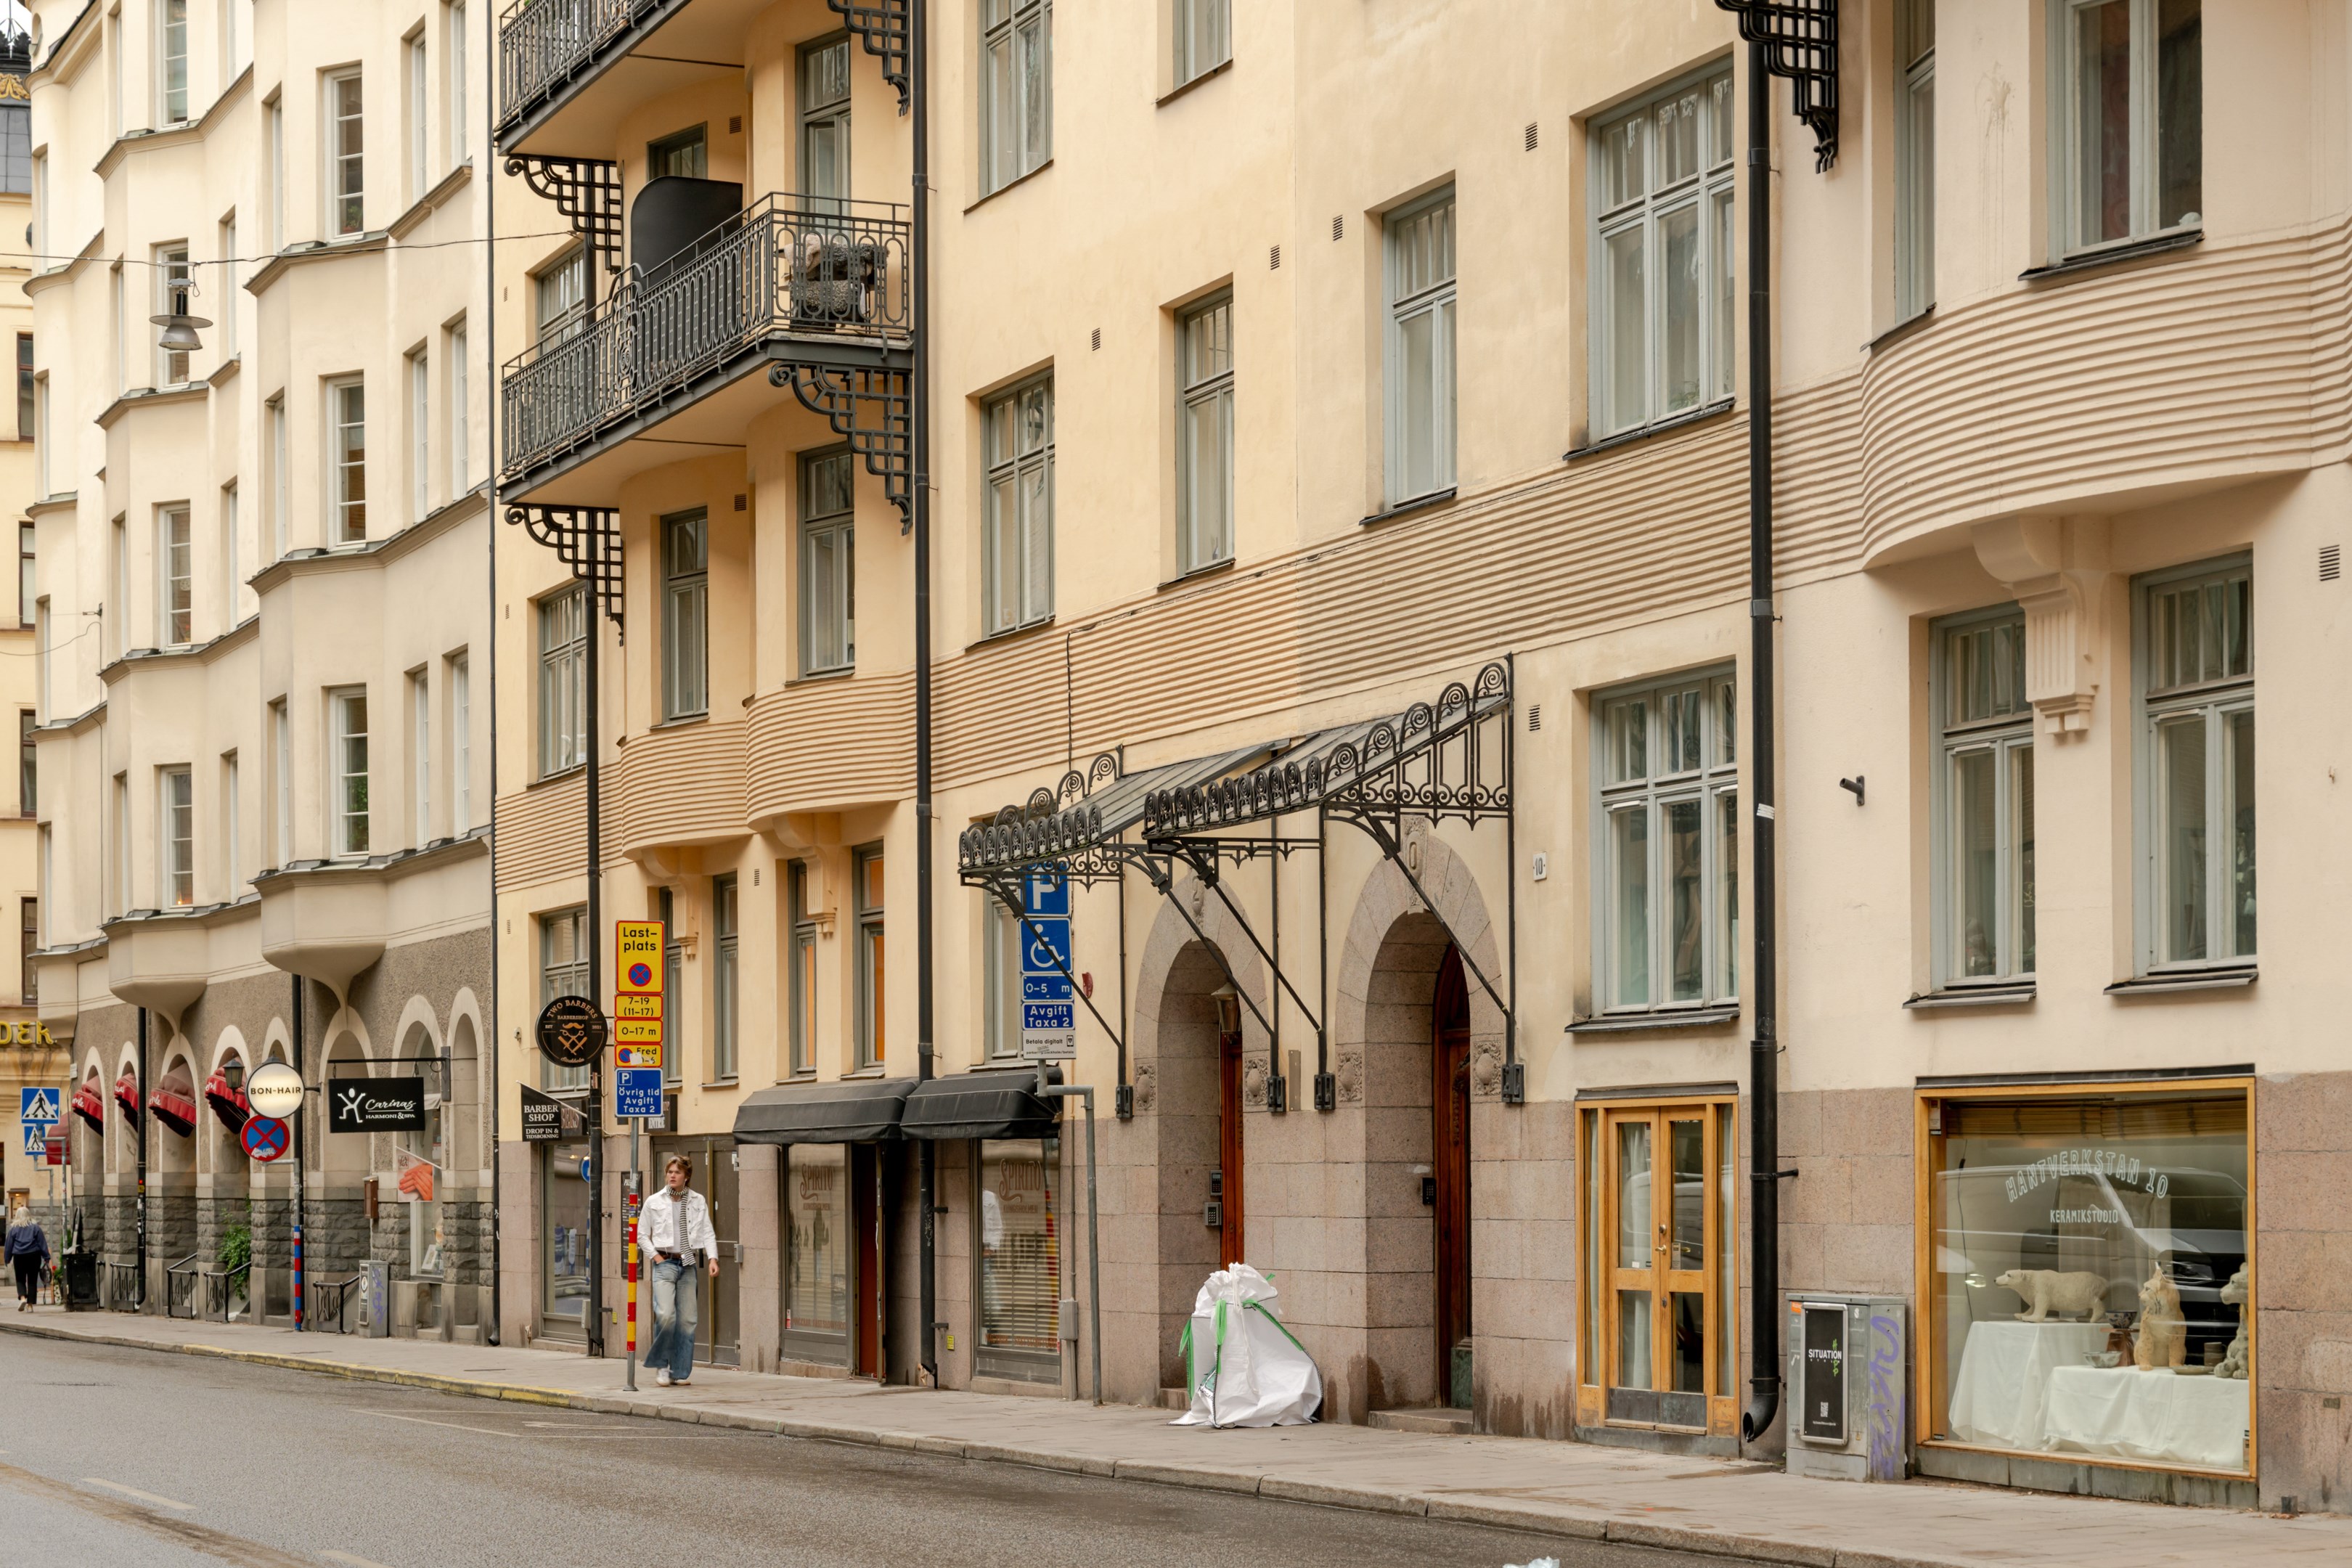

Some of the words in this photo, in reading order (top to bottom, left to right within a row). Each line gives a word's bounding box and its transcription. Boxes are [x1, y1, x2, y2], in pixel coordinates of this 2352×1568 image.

[1535, 857, 1543, 875] 10
[1032, 866, 1060, 910] P
[623, 927, 658, 938] Last-
[624, 940, 657, 953] plats
[1026, 983, 1048, 993] 0-5
[547, 1003, 563, 1018] TWO
[565, 1000, 598, 1018] BARBERS
[624, 1007, 654, 1016] (11-17)
[1030, 1006, 1067, 1017] Avgift
[1028, 1018, 1058, 1027] Taxa
[1062, 1018, 1069, 1027] 2
[621, 1072, 629, 1084] P
[618, 1087, 644, 1097] Övrig
[365, 1098, 417, 1110] Carinas
[999, 1159, 1041, 1203] SPIRITO
[2006, 1149, 2139, 1202] HANTVERKSTAN
[2146, 1167, 2168, 1198] 10
[800, 1164, 833, 1201] SPIRITO
[2050, 1209, 2118, 1222] KERAMIKSTUDIO
[1808, 1349, 1842, 1359] SITUATION
